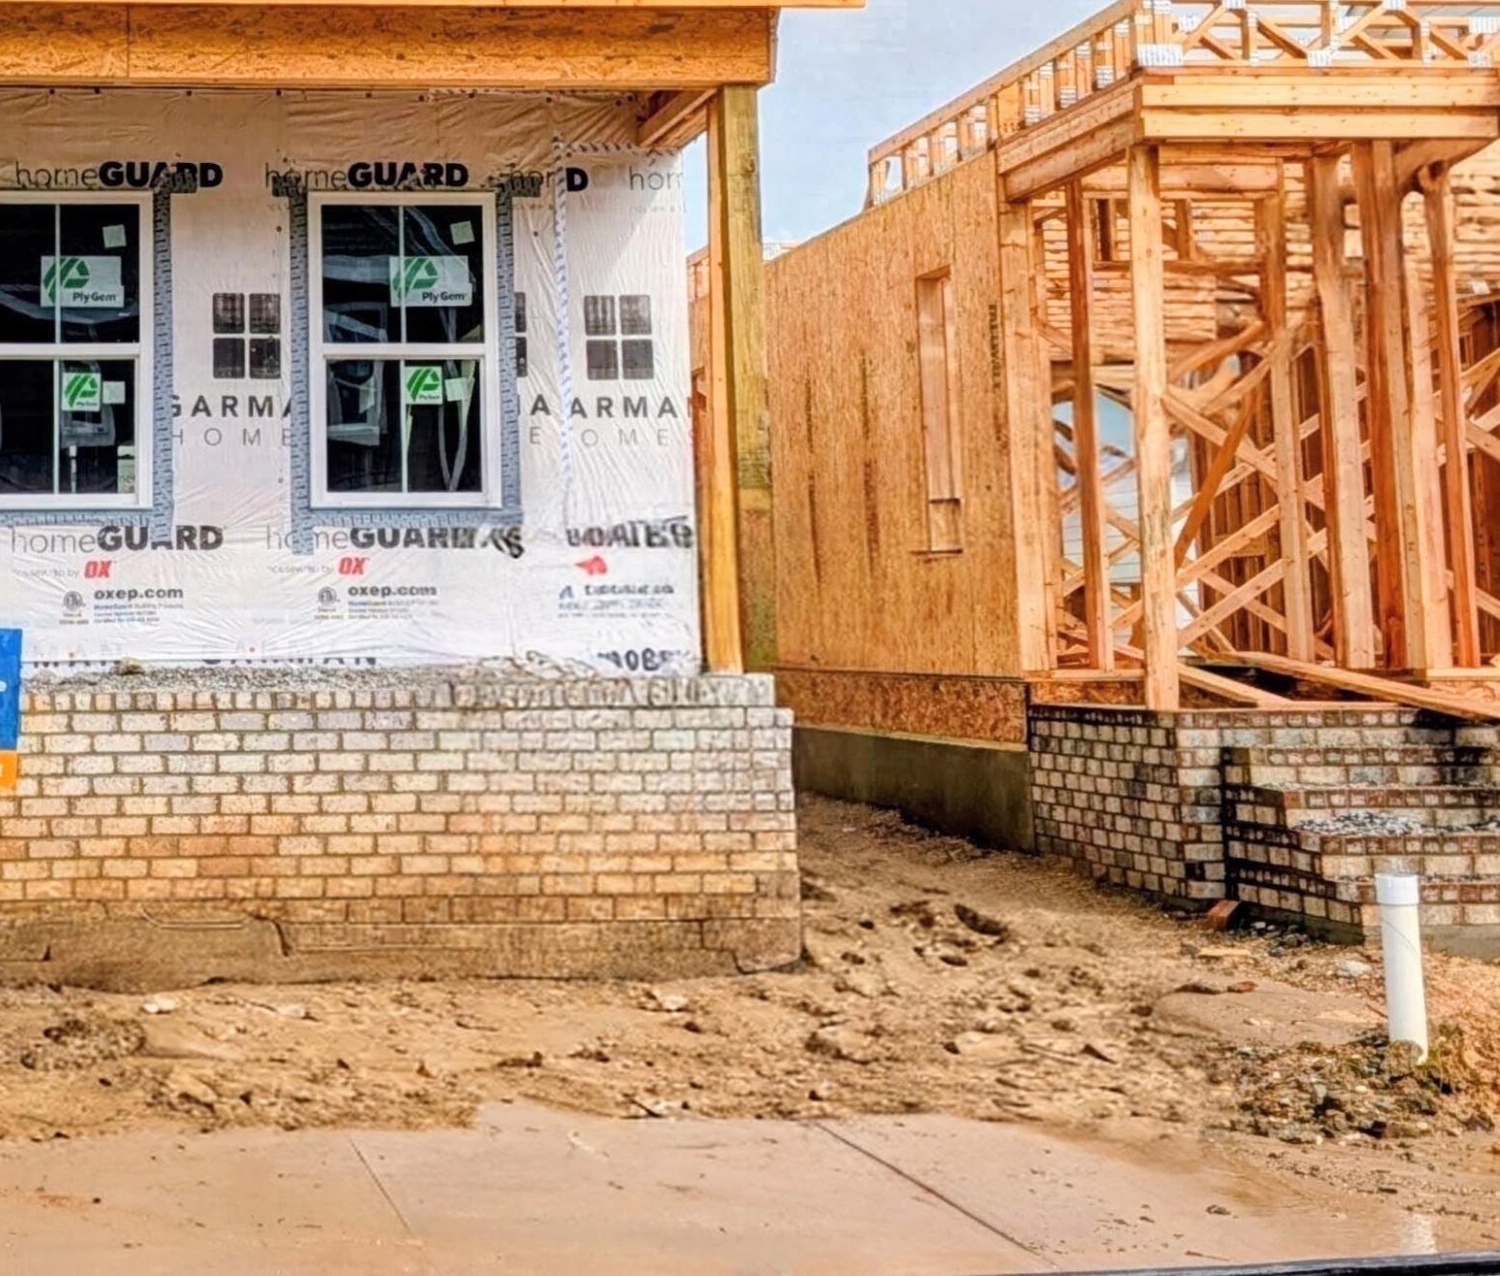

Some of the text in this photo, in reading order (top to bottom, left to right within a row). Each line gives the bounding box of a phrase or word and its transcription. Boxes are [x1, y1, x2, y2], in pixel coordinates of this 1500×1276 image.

[72, 291, 116, 303] Ply Gem
[422, 291, 465, 303] Ply Gem
[84, 560, 112, 579] OX
[338, 557, 366, 575] OX
[94, 587, 184, 600] oxep.com
[348, 585, 437, 598] oxep.com
